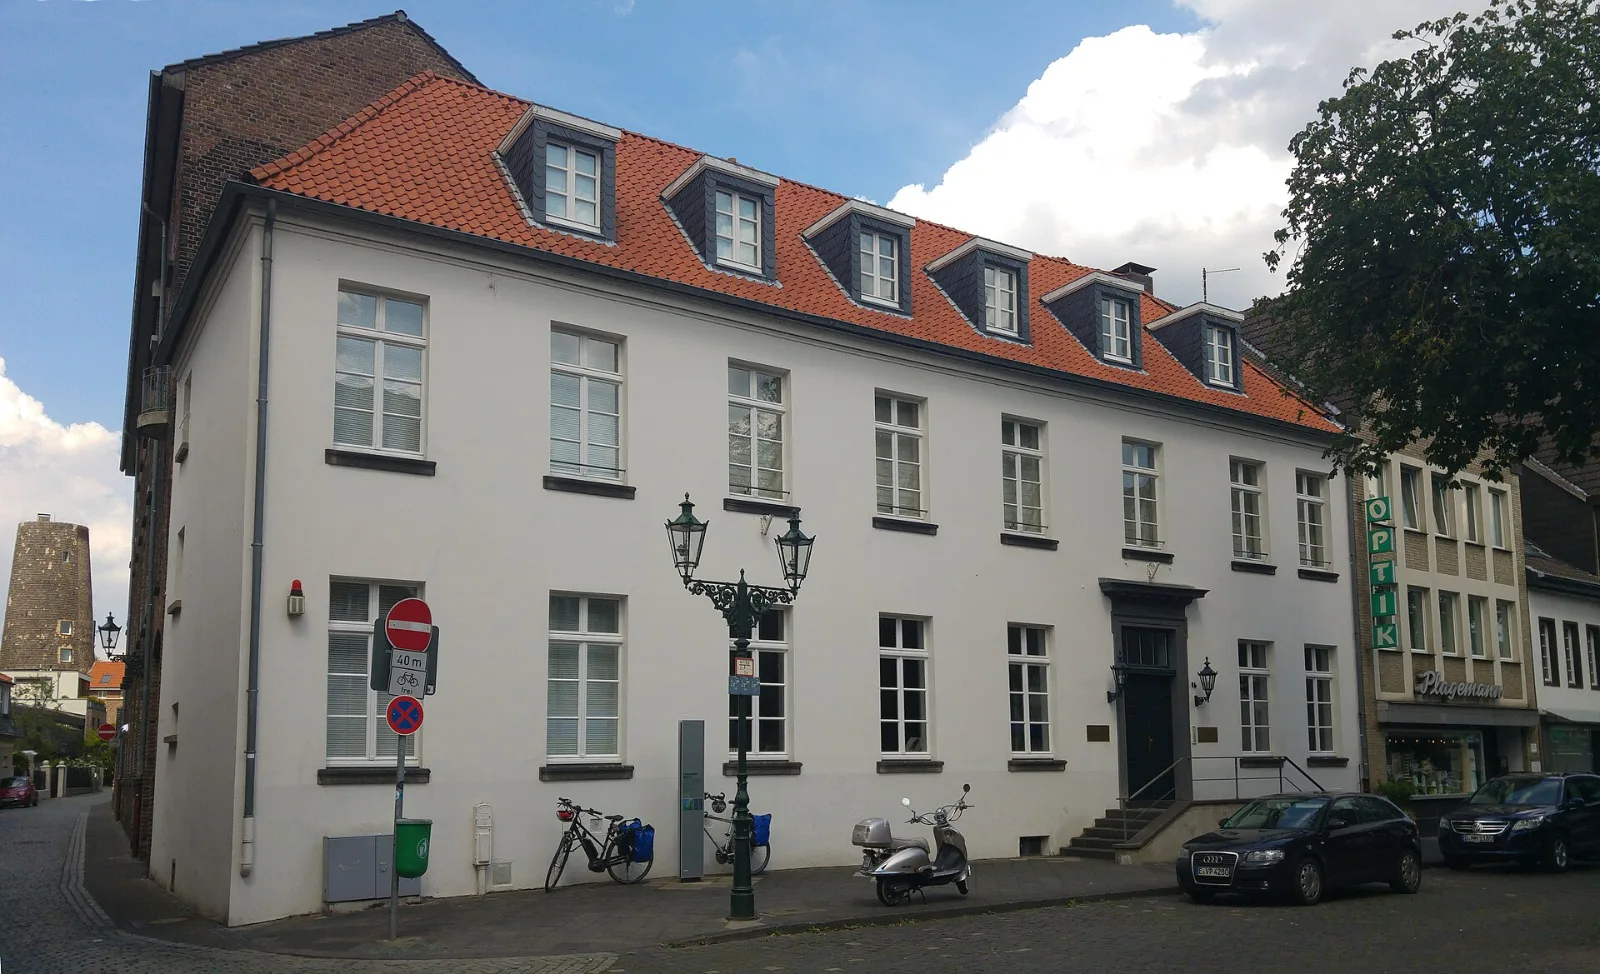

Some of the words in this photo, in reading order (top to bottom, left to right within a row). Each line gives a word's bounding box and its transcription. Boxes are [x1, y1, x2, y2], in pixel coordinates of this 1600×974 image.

[1369, 499, 1395, 646] OPTIK
[397, 654, 410, 666] 40
[412, 658, 422, 667] m
[401, 686, 413, 695] frei
[1419, 670, 1504, 700] Plagemann
